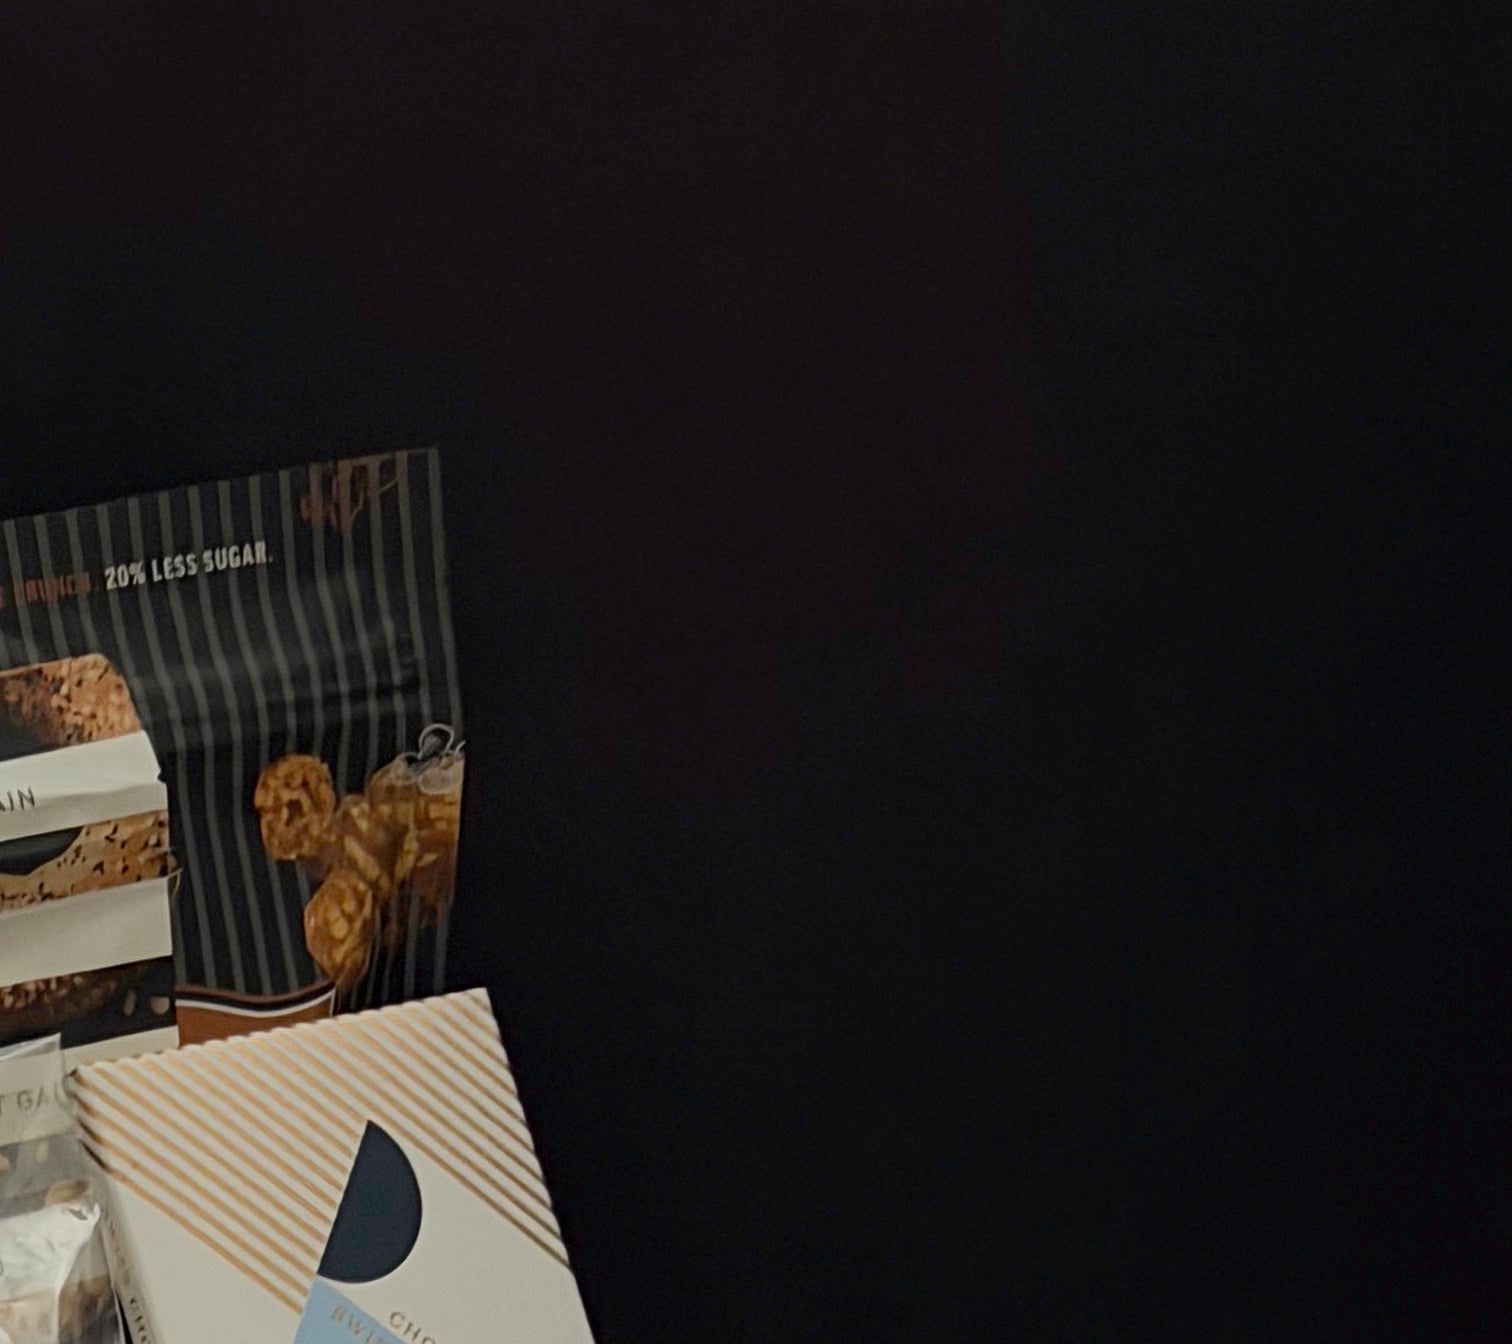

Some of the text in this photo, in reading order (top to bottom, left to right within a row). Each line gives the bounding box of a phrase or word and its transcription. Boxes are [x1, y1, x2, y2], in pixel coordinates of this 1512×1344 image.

[105, 561, 146, 591] 20%
[151, 553, 198, 583] LESS
[203, 540, 274, 573] SUGAR.
